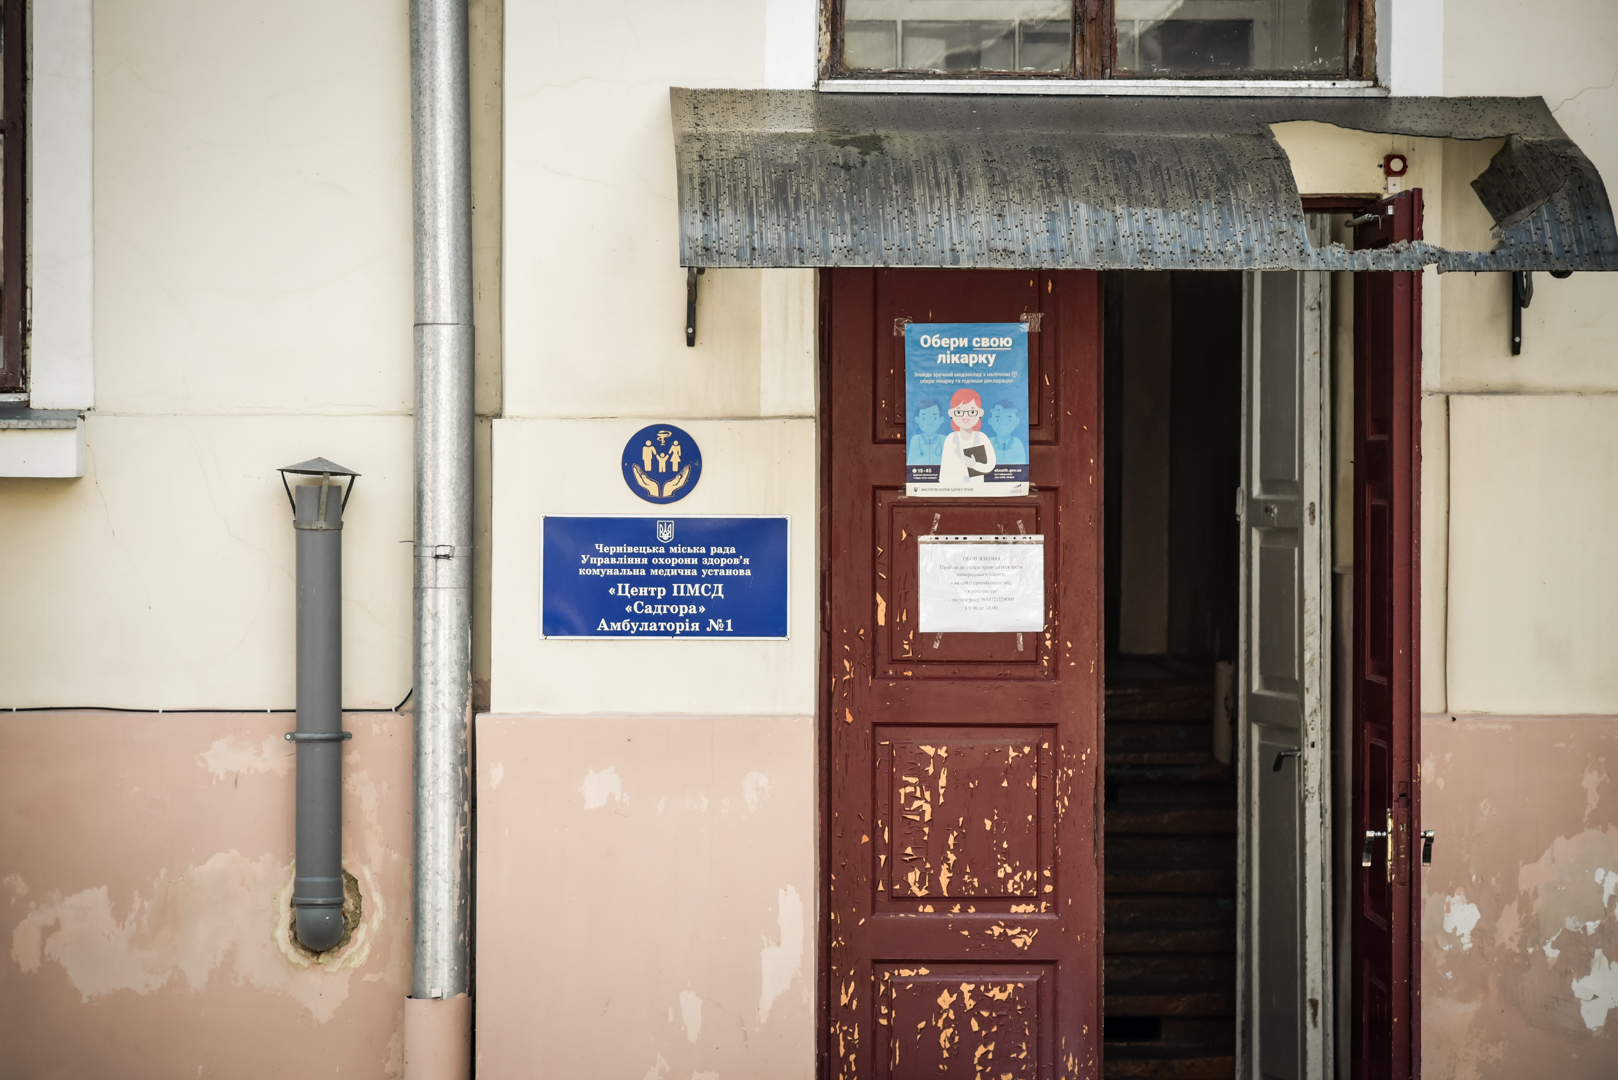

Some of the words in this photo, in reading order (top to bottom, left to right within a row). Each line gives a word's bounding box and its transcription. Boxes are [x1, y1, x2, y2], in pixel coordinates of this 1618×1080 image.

[920, 334, 968, 350] Обери
[972, 337, 1012, 348] свою
[937, 350, 996, 367] лікарку
[594, 543, 665, 554] Чернівецька
[669, 544, 706, 554] міська
[710, 546, 736, 555] рада
[581, 555, 648, 566] Управління
[652, 557, 698, 566] охорони
[702, 556, 750, 566] здоров'я
[579, 567, 646, 577] комунальна
[650, 568, 698, 577] медична
[702, 568, 752, 578] установа
[608, 583, 666, 599] «Центр
[672, 583, 724, 599] ПМСД
[625, 601, 706, 617] «Садгора»
[597, 618, 700, 634] Амбулаторія
[706, 618, 734, 632] №1
